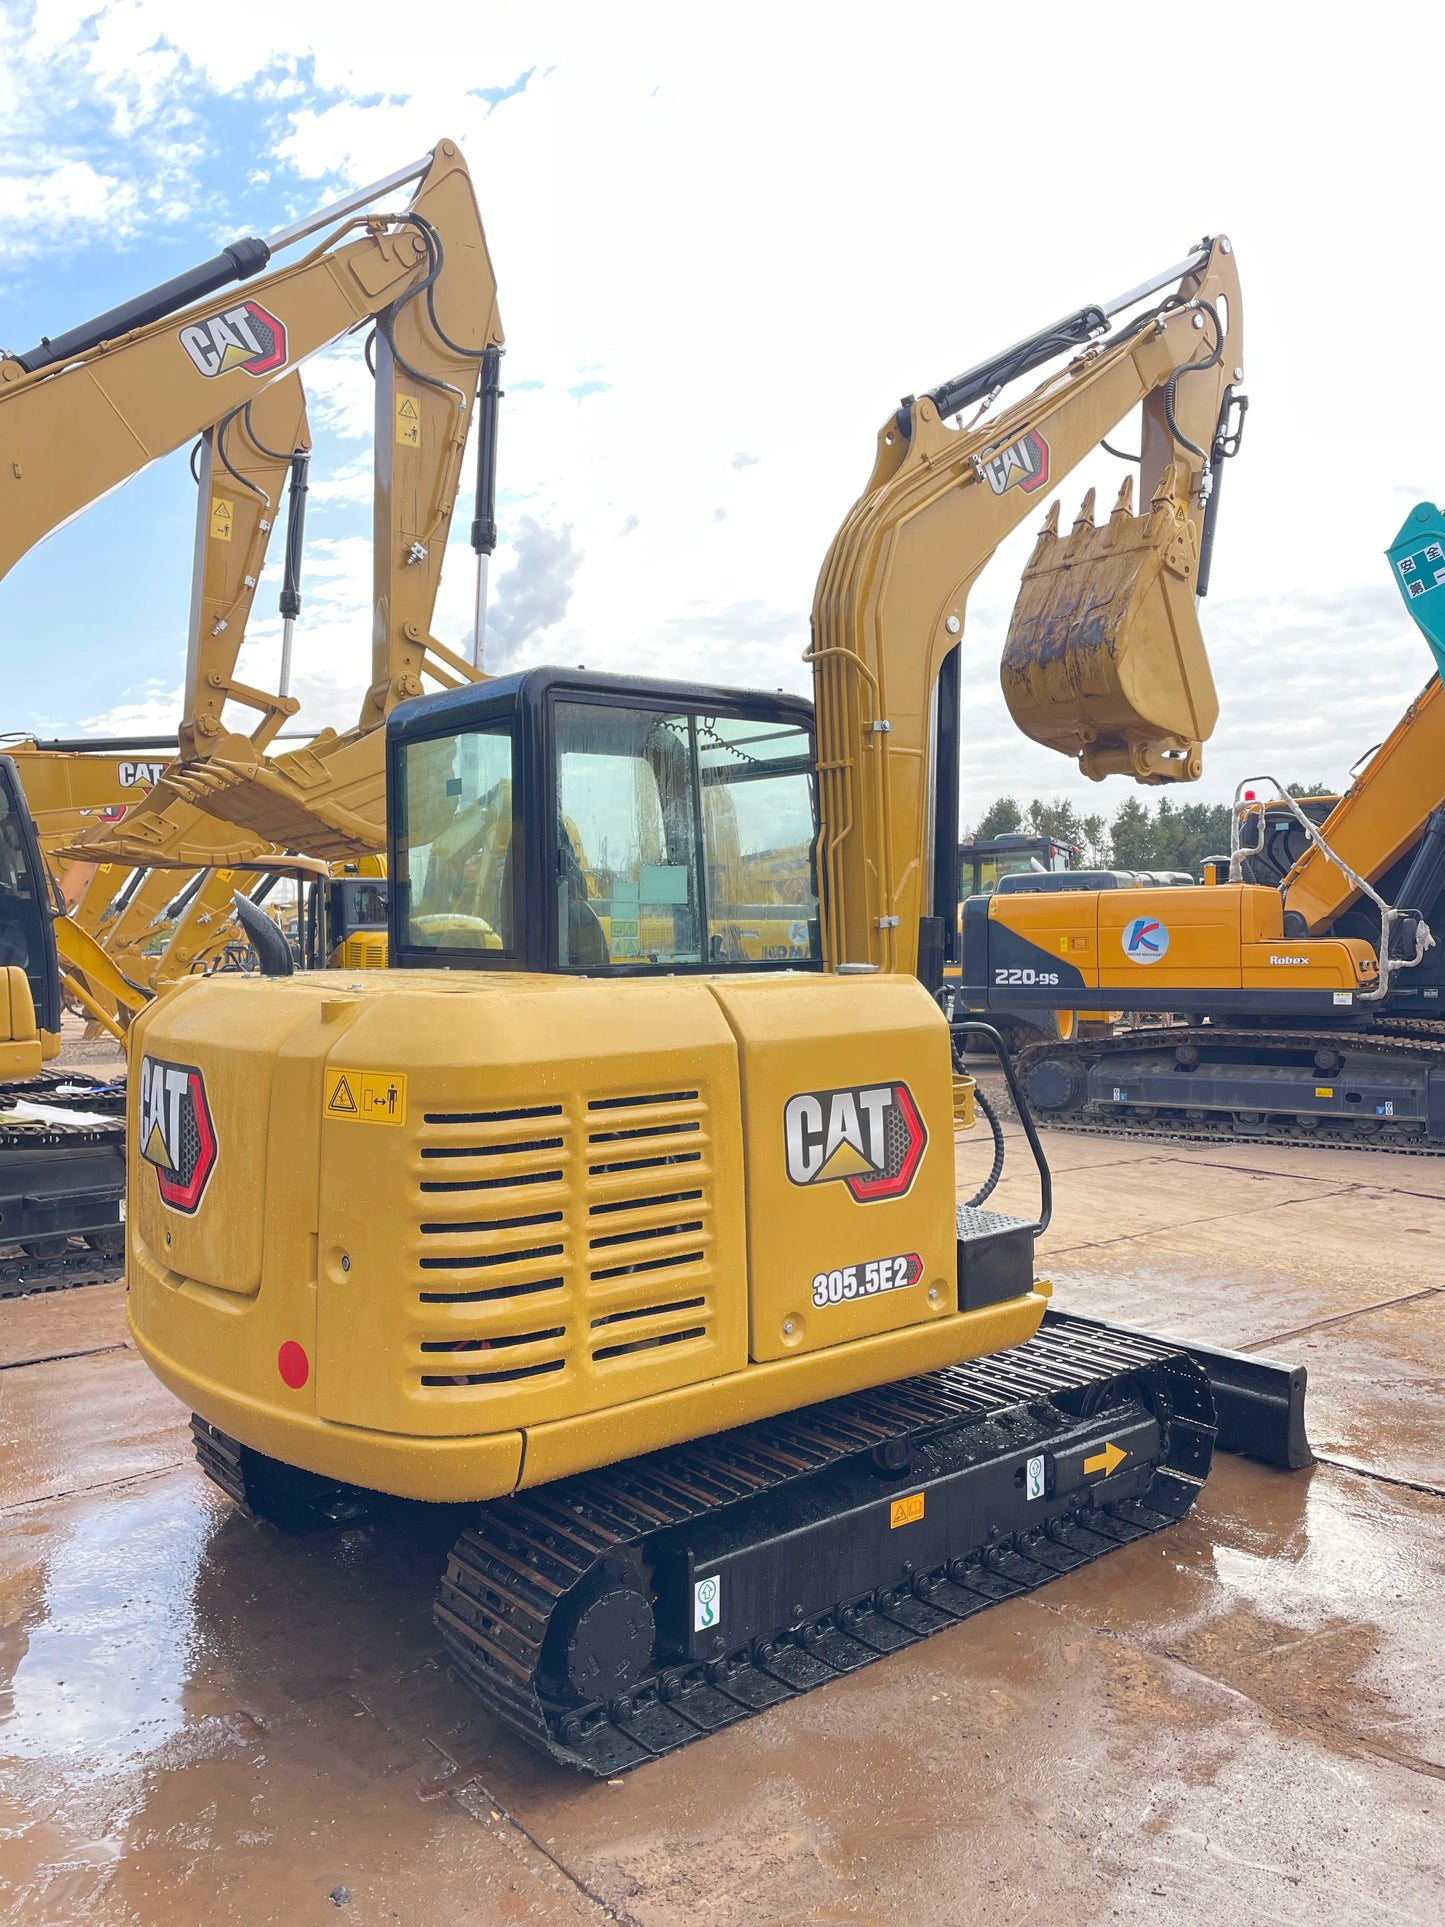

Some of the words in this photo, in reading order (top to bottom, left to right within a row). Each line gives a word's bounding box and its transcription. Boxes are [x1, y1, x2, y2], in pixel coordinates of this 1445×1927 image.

[180, 306, 264, 377] CAT
[119, 762, 164, 788] CAT
[995, 969, 1059, 985] 220-9S
[1269, 955, 1310, 965] Robex
[139, 1055, 189, 1172] CAT
[785, 1087, 893, 1183] CAT
[813, 1256, 909, 1306] 305.5E2
